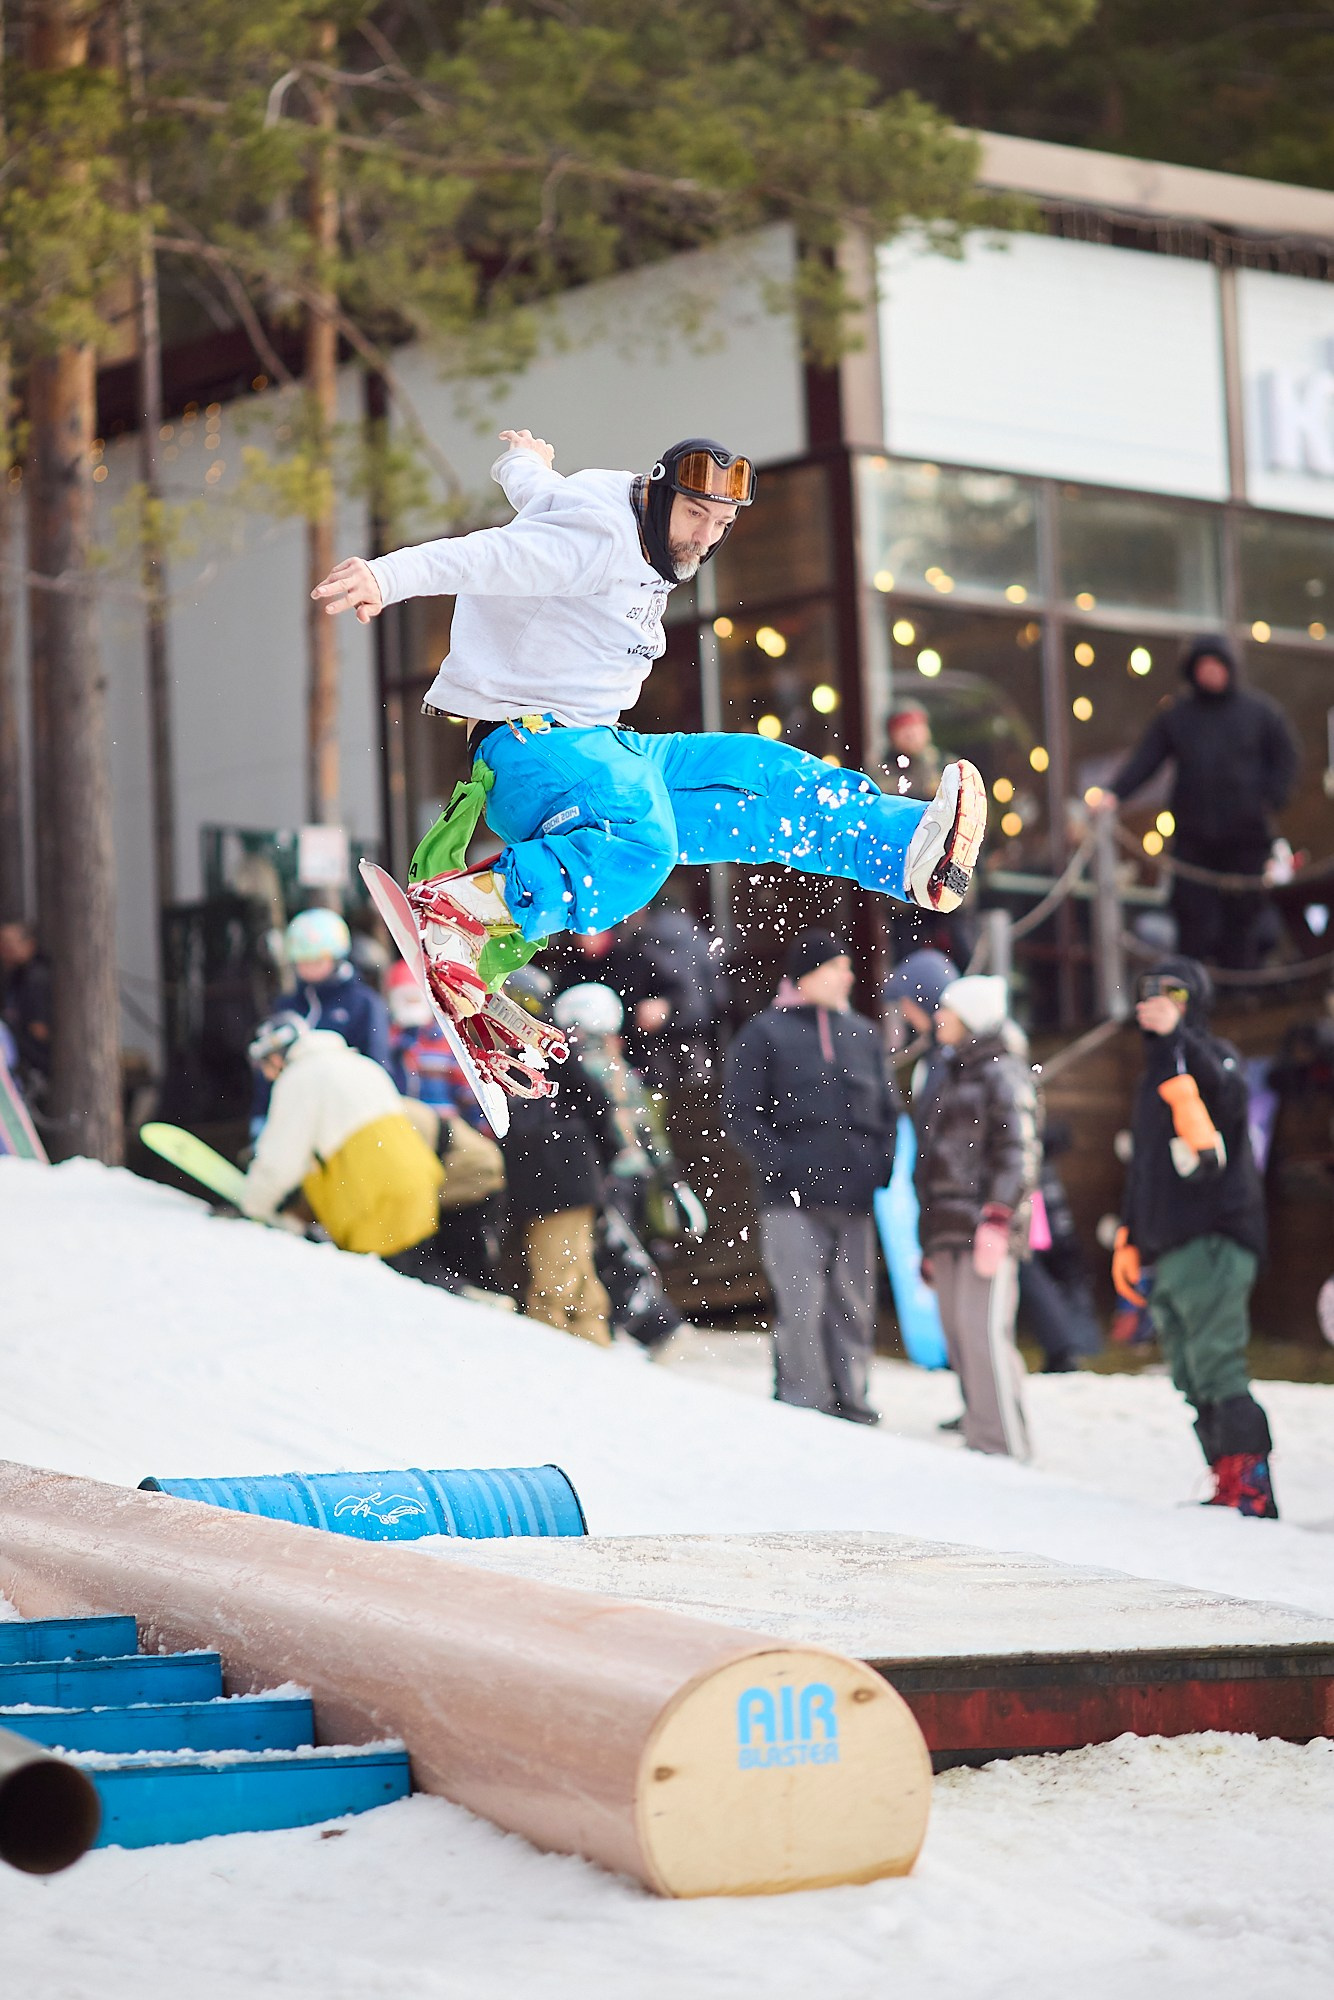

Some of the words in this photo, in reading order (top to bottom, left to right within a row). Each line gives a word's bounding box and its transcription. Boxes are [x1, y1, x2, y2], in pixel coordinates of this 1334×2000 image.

[543, 815, 560, 832] SOCHI
[560, 807, 578, 821] 2014
[737, 1682, 838, 1745] AIR
[738, 1742, 839, 1770] BLASTER
